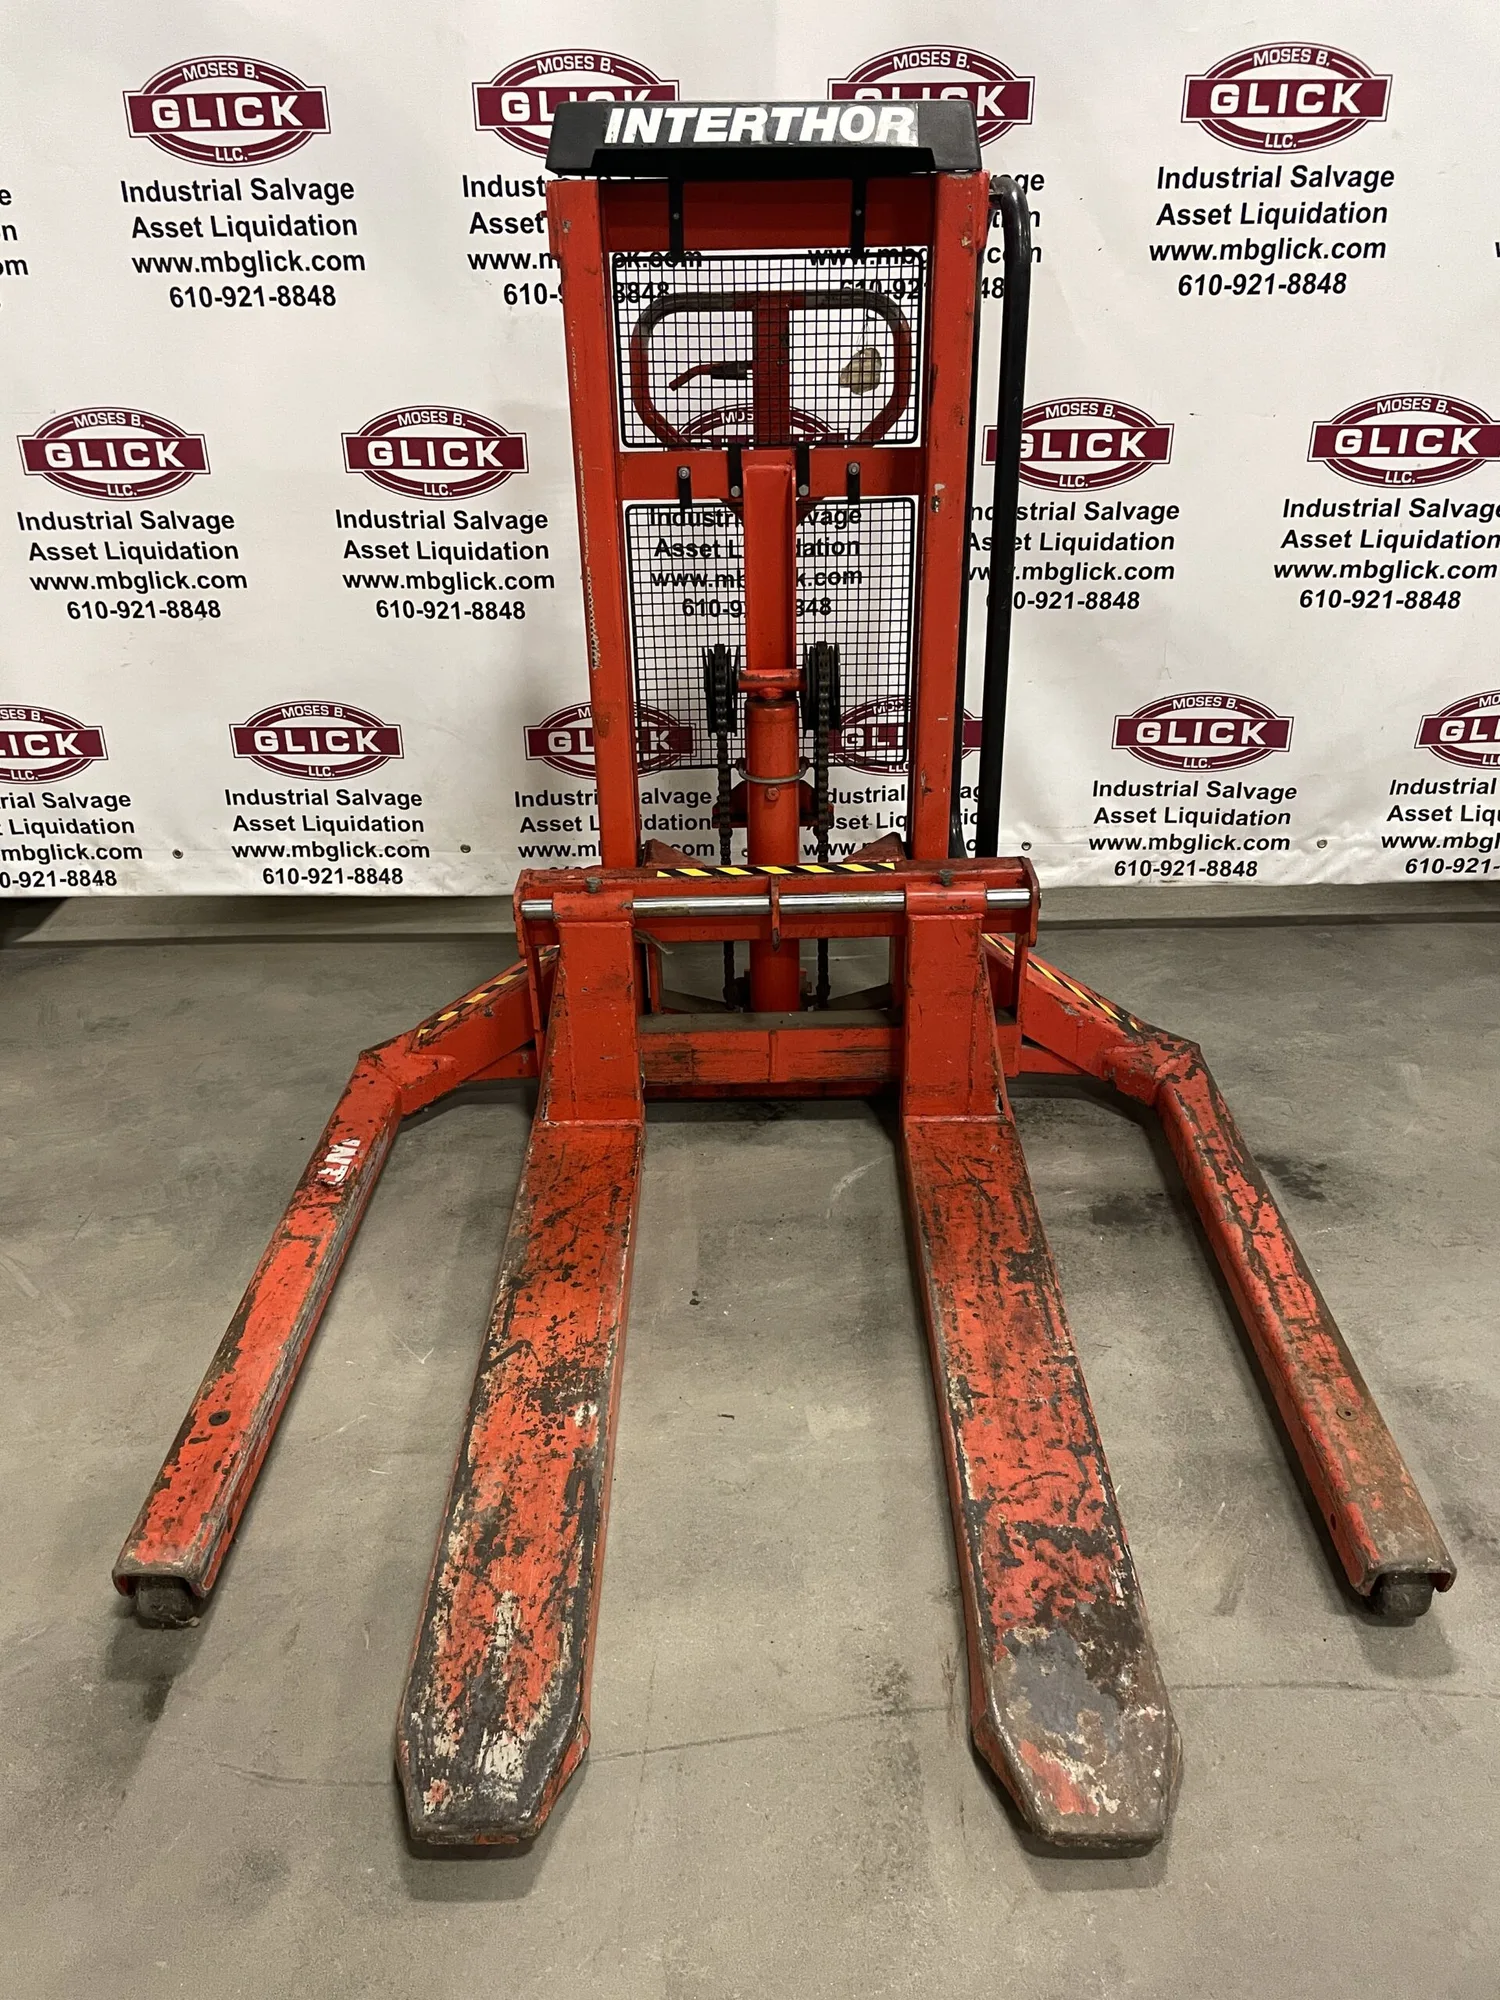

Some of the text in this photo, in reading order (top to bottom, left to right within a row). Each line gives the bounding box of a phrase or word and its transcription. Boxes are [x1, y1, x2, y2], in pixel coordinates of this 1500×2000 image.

[536, 56, 615, 74] MOSES B.
[893, 52, 970, 70] MOSES B.
[1253, 48, 1330, 66] MOSES B.
[182, 62, 260, 81] MOSES B.
[1209, 82, 1362, 114] GLICK
[152, 95, 303, 129] GLICK
[604, 105, 918, 144] INTERTHOR
[1264, 133, 1297, 148] LLC.
[215, 147, 248, 161] LLC.
[463, 175, 546, 197] Indust
[1157, 164, 1395, 193] Industrial Salvage
[121, 178, 355, 203] Industrial Salvage
[469, 212, 545, 234] Asset
[1156, 202, 1388, 229] Asset Liquidation
[132, 213, 358, 242] Asset Liquidation
[1149, 238, 1387, 265] www.mbglick.com
[132, 252, 365, 276] www.mbglick.com
[1178, 272, 1347, 296] 610-921-8848
[170, 284, 336, 308] 610-921-8848
[1045, 403, 1116, 418] MOSES B.
[1376, 398, 1449, 414] MOSES B.
[73, 412, 144, 428] MOSES B.
[397, 410, 466, 427] MOSES B.
[1334, 428, 1481, 454] GLICK
[44, 441, 185, 468] GLICK
[367, 440, 503, 467] GLICK
[1059, 475, 1088, 487] LLC.
[1384, 471, 1415, 483] LLC.
[106, 484, 137, 496] LLC.
[424, 484, 453, 496] LLC.
[1084, 502, 1180, 524] Salvage
[1283, 498, 1400, 518] Industrial
[17, 510, 235, 534] Industrial Salvage
[335, 509, 549, 534] Industrial Salvage
[654, 538, 721, 558] Asset
[969, 532, 1175, 555] Aset Liquidation
[1281, 529, 1500, 553] Asset Liquidation
[29, 541, 239, 564] Asset Liquidation
[343, 540, 549, 565] Asset Liquidation
[29, 571, 248, 594] www.mbglick.com
[1273, 560, 1498, 584] www.mbglick.com
[342, 571, 555, 595] www.mbglick.com
[67, 600, 222, 620] 610-921-8848
[376, 600, 526, 620] 610-921-8848
[987, 591, 1140, 610] 0-921-8848
[1300, 590, 1461, 609] 610-921-8848
[281, 705, 346, 718] MOSES B.
[1173, 697, 1237, 710] MOSES B.
[31, 710, 45, 722] B.
[253, 730, 381, 752] GLICK
[548, 730, 671, 752] GLK
[841, 726, 903, 747] GLI
[1136, 721, 1267, 745] GLICK
[0, 732, 84, 756] ICK
[308, 766, 335, 777] LLC.
[1183, 758, 1211, 768] LLC.
[10, 770, 38, 780] LLC.
[827, 784, 906, 804] dustrial
[1093, 780, 1297, 804] Industrial Salvage
[1389, 778, 1497, 795] Industrial
[41, 792, 132, 812] Salvage
[225, 789, 423, 810] Industrial Salvage
[514, 788, 712, 808] Industri alvage
[520, 814, 712, 833] Asset Lidation
[1094, 807, 1291, 828] Asset Liquidation
[1386, 805, 1453, 822] Asset
[8, 818, 135, 839] Liquidation
[233, 815, 424, 836] Asset Liquidation
[231, 841, 430, 862] www.mbglick.com
[1089, 834, 1290, 854] www.mbglick.com
[1381, 832, 1500, 854] www.mbgl
[0, 843, 143, 865] mbglick.com
[262, 867, 404, 885] 610-921-8848
[1114, 860, 1257, 877] 610-921-8848
[1405, 858, 1500, 874] 610-921-
[0, 870, 118, 888] 0-921-8848
